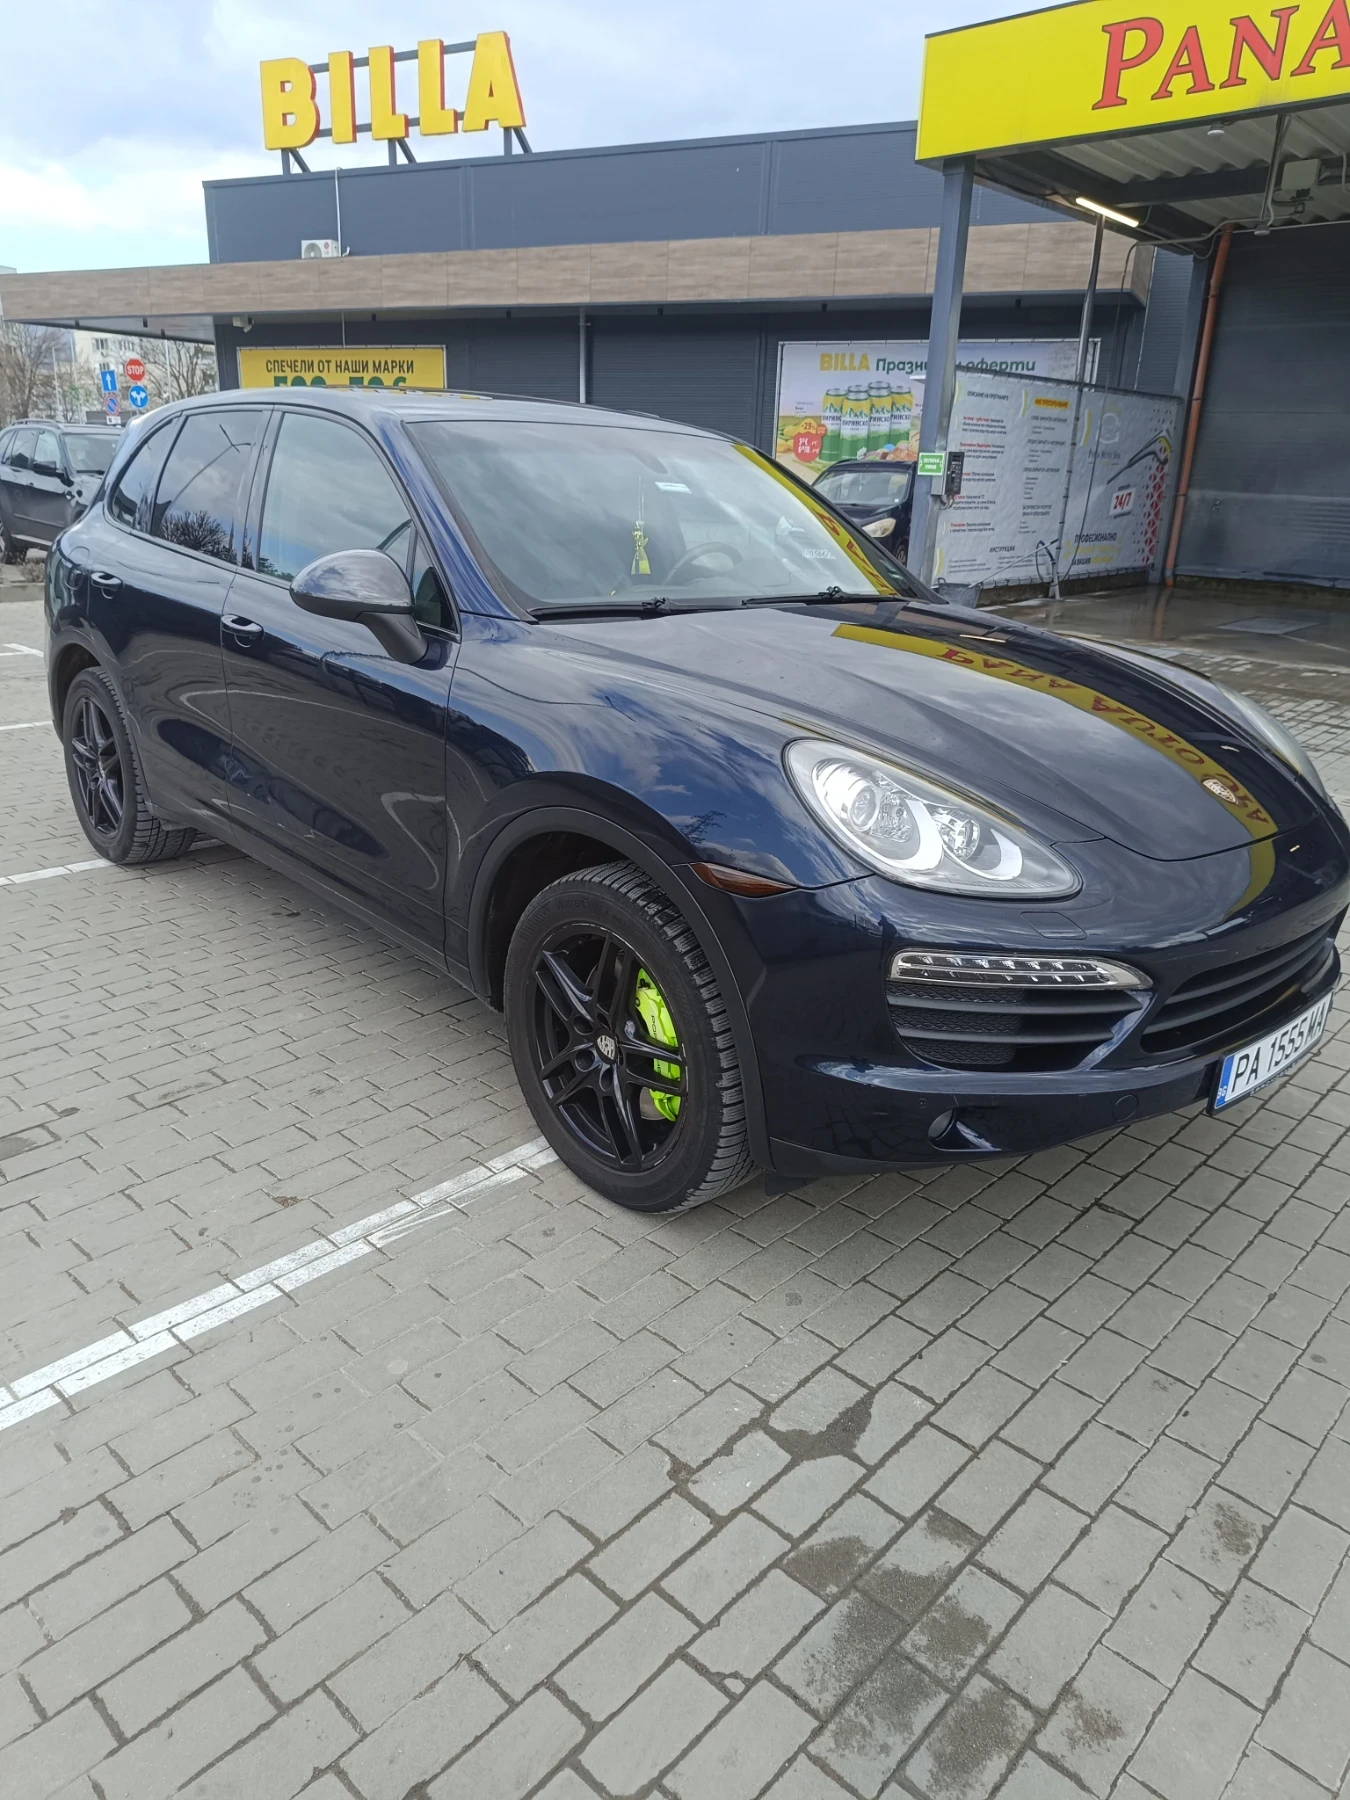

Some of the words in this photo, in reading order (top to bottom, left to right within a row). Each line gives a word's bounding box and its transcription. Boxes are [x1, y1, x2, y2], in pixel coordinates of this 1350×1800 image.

[1091, 0, 1350, 111] PANA
[260, 31, 526, 150] BILLA
[126, 365, 144, 375] STOP
[266, 359, 314, 373] СПЕЧЕЛИ
[318, 359, 331, 373] ОТ
[335, 359, 369, 373] НАШИ
[373, 359, 414, 374] МАРКИ
[819, 352, 870, 371] BILLA
[1113, 492, 1132, 510] 24/7
[1231, 1047, 1261, 1093] PA
[1267, 1016, 1308, 1073] 1555
